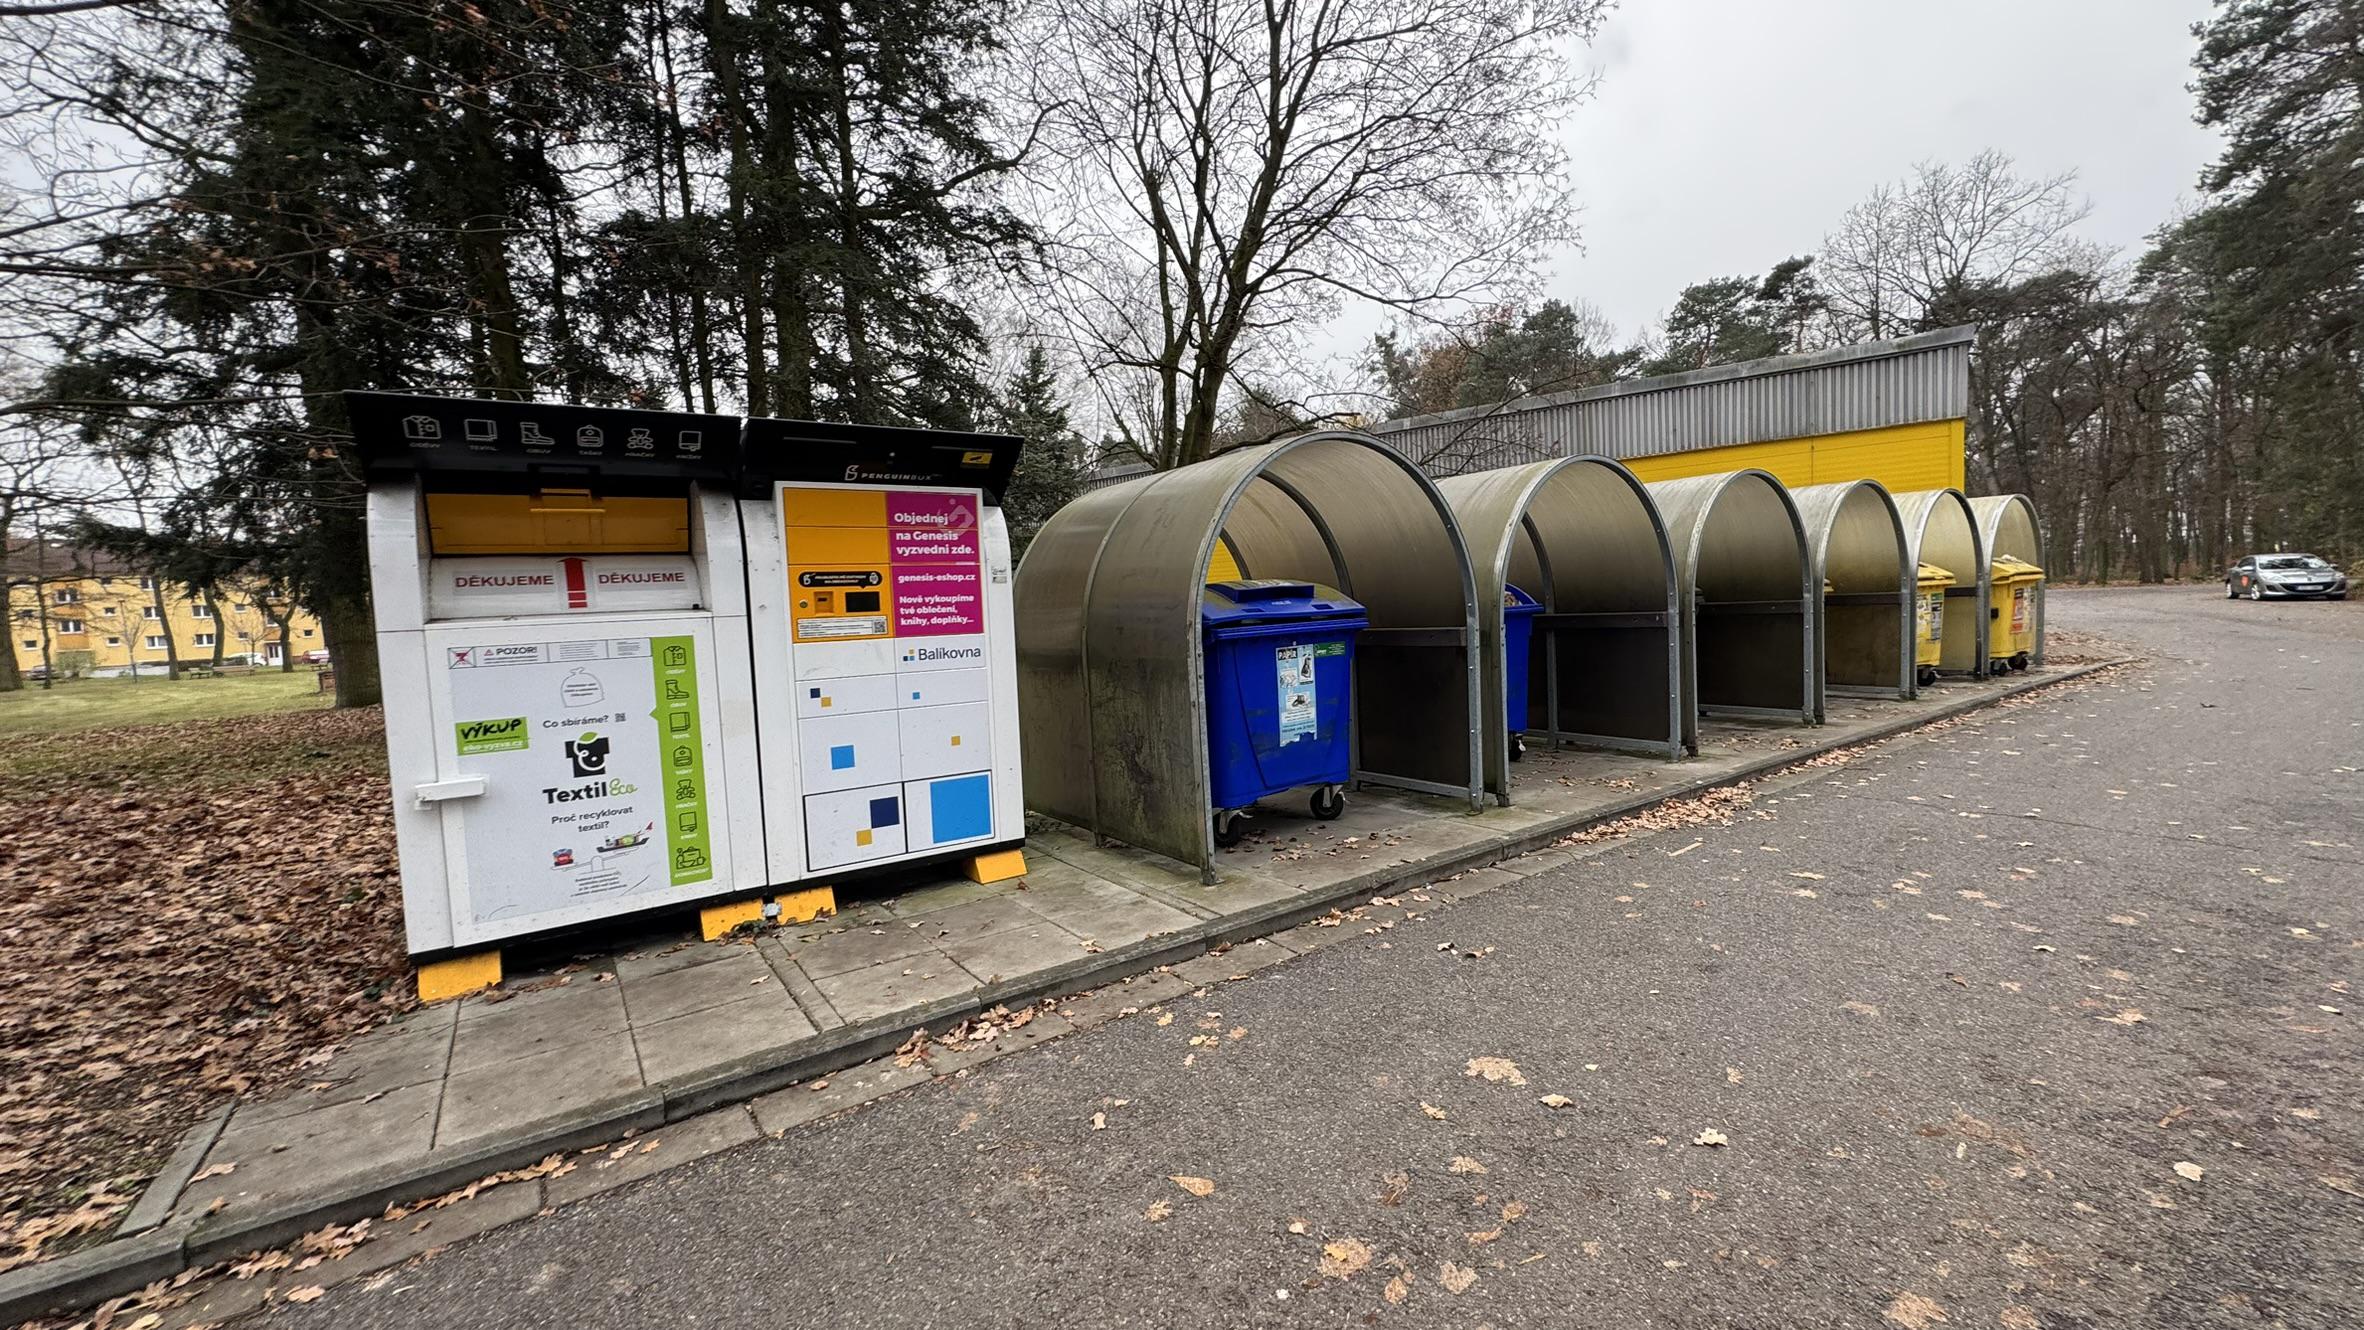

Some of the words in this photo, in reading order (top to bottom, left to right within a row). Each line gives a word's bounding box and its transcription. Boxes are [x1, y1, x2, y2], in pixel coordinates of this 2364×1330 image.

[861, 472, 932, 481] PENGUINBOX
[894, 512, 949, 525] Objednej
[896, 532, 911, 540] na
[912, 530, 959, 541] Genesis
[896, 543, 950, 557] vyzvedni
[951, 544, 975, 555] zde.
[455, 574, 554, 588] DĚKUJEME
[598, 571, 685, 585] DĚKUJEME
[898, 573, 976, 583] genesis-eshop.cz
[924, 594, 975, 604] vykoupíme
[900, 606, 915, 614] tvé
[916, 605, 958, 614] oblečení,
[901, 617, 930, 627] knihy,
[496, 646, 538, 656] POZOR!
[918, 647, 982, 660] Balíkovna
[542, 719, 558, 729] Co
[561, 714, 610, 727] sbíráme?
[461, 718, 522, 740] VÝKUP
[551, 813, 577, 824] Proč
[579, 806, 633, 821] recyklovat
[578, 820, 610, 832] textil?
